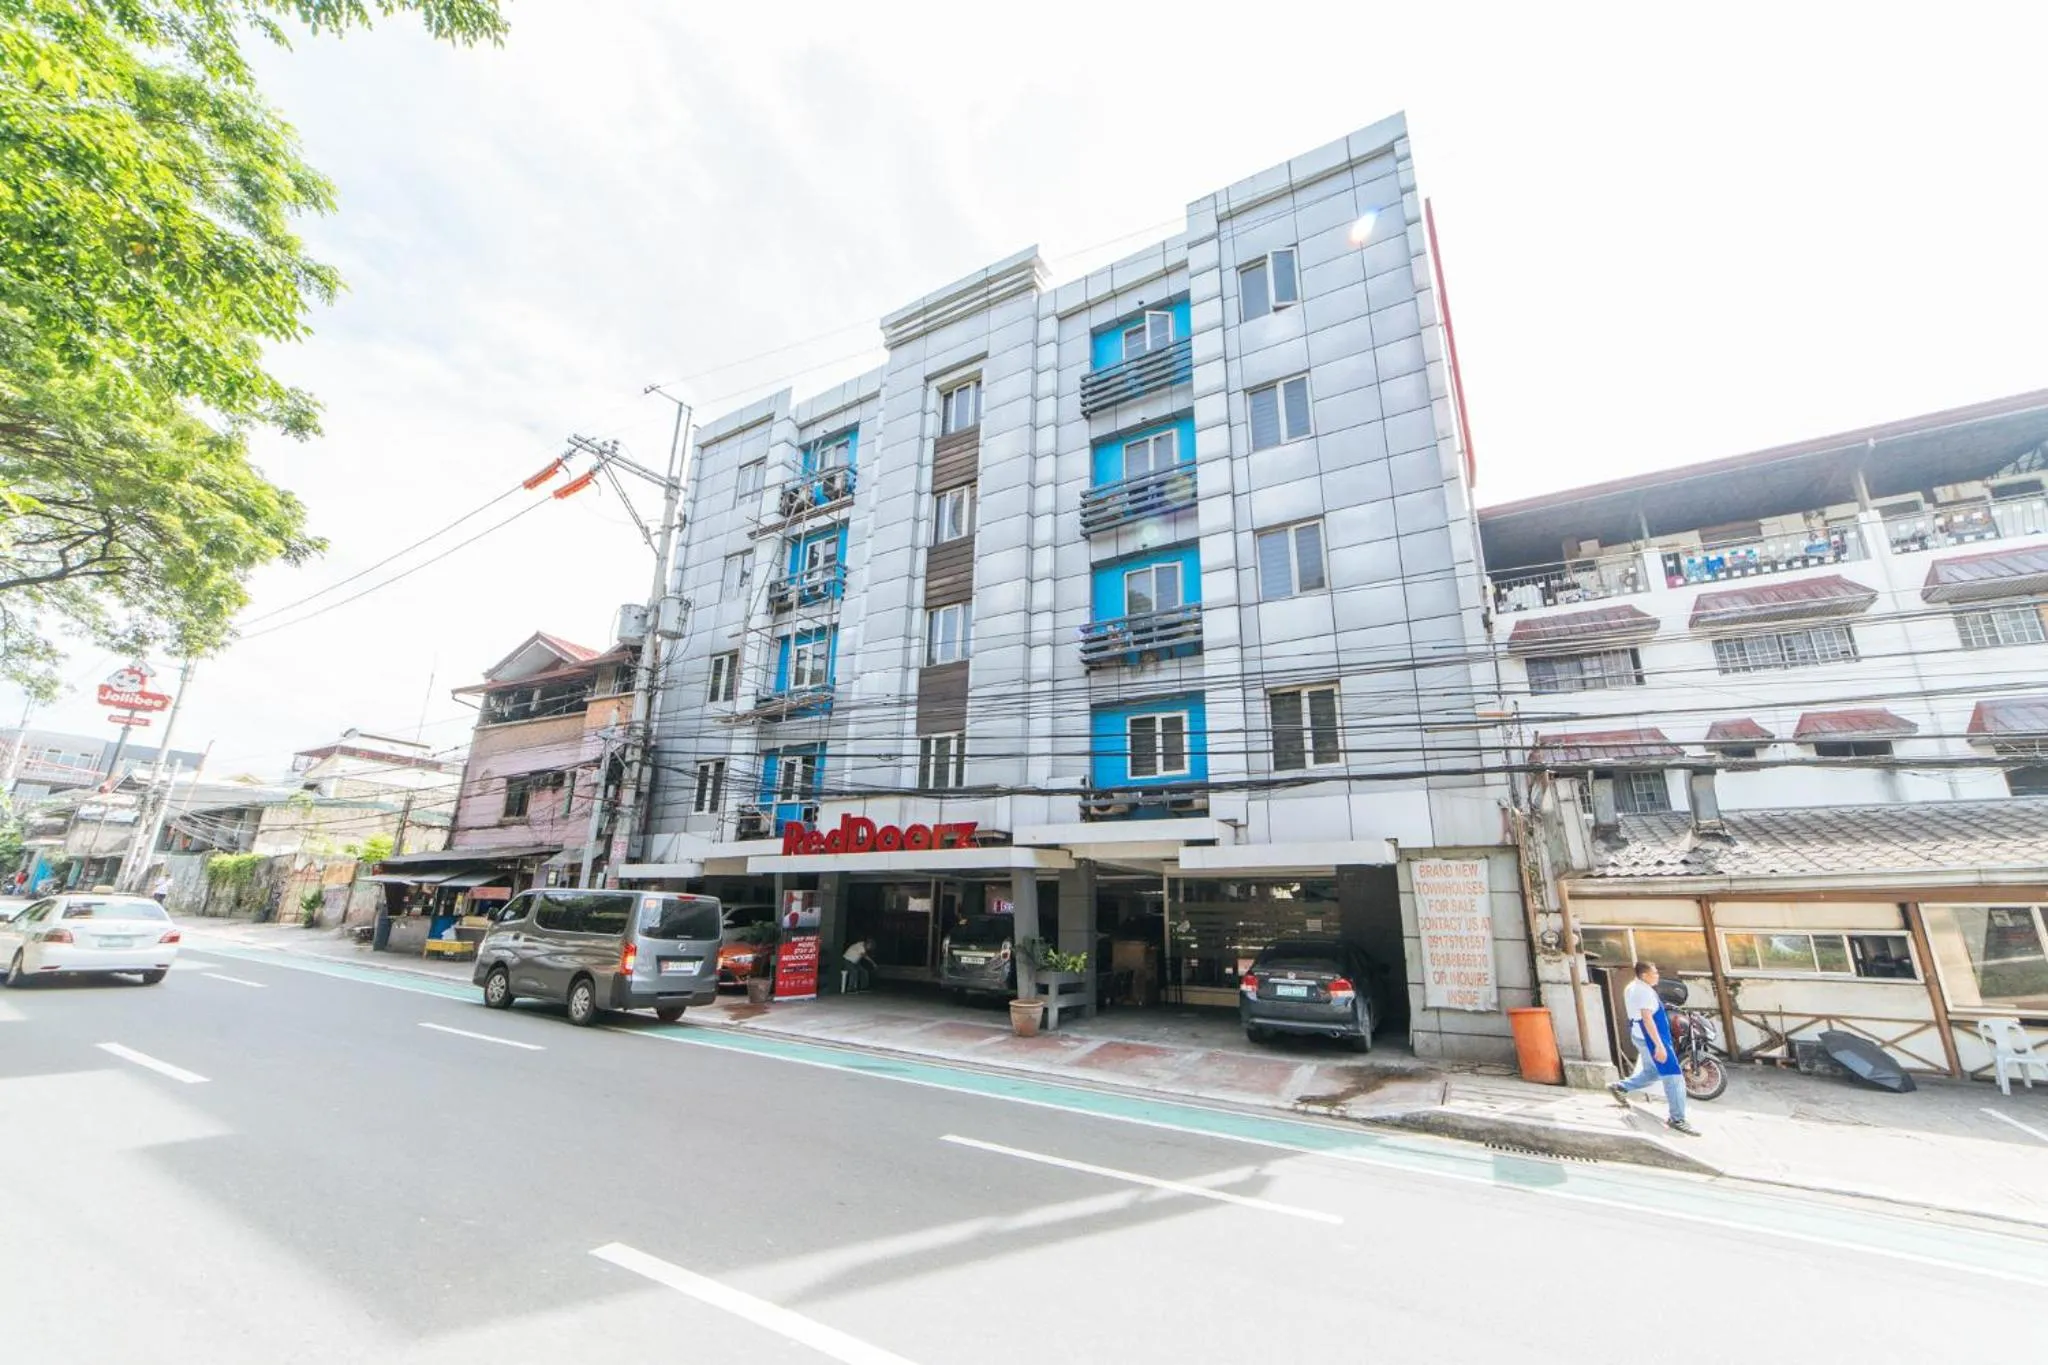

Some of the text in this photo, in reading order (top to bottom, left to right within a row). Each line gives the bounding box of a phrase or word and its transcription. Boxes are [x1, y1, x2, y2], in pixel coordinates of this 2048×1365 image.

[100, 689, 162, 707] Jollibee
[782, 812, 979, 856] RedDoorz
[1419, 862, 1478, 878] BRAND NEW
[1416, 881, 1485, 896] TOWNHOUSES
[1428, 898, 1477, 913] FOR SALE
[1466, 916, 1479, 931] US
[1433, 971, 1447, 985] OR
[1447, 989, 1480, 1005] INSIDE
